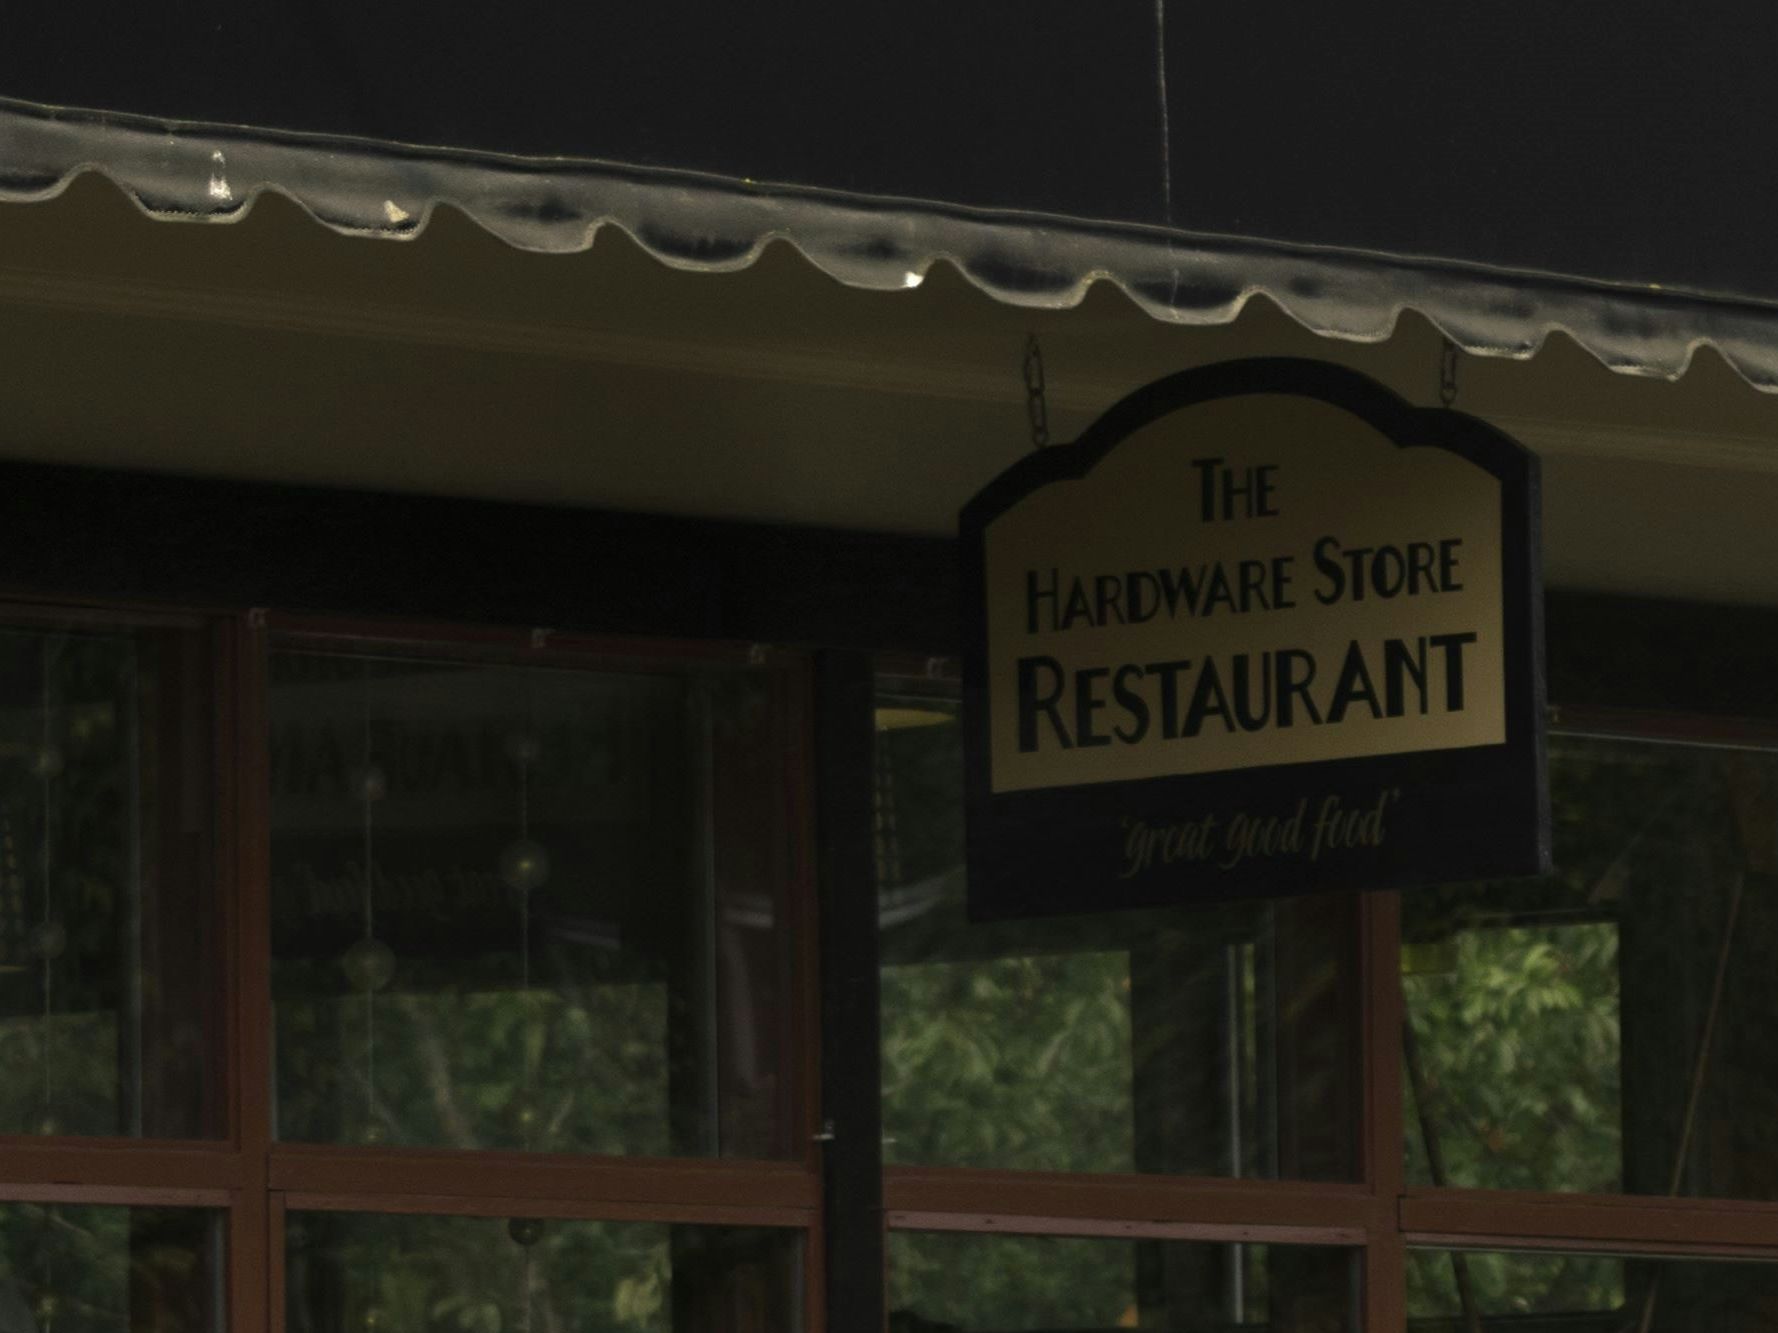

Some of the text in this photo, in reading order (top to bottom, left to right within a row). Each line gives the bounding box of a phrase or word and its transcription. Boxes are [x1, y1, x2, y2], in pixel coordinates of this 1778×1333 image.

[1191, 456, 1280, 524] THE
[1025, 535, 1463, 635] HARDWARE STORE
[1016, 631, 1478, 754] RESTAURANT
